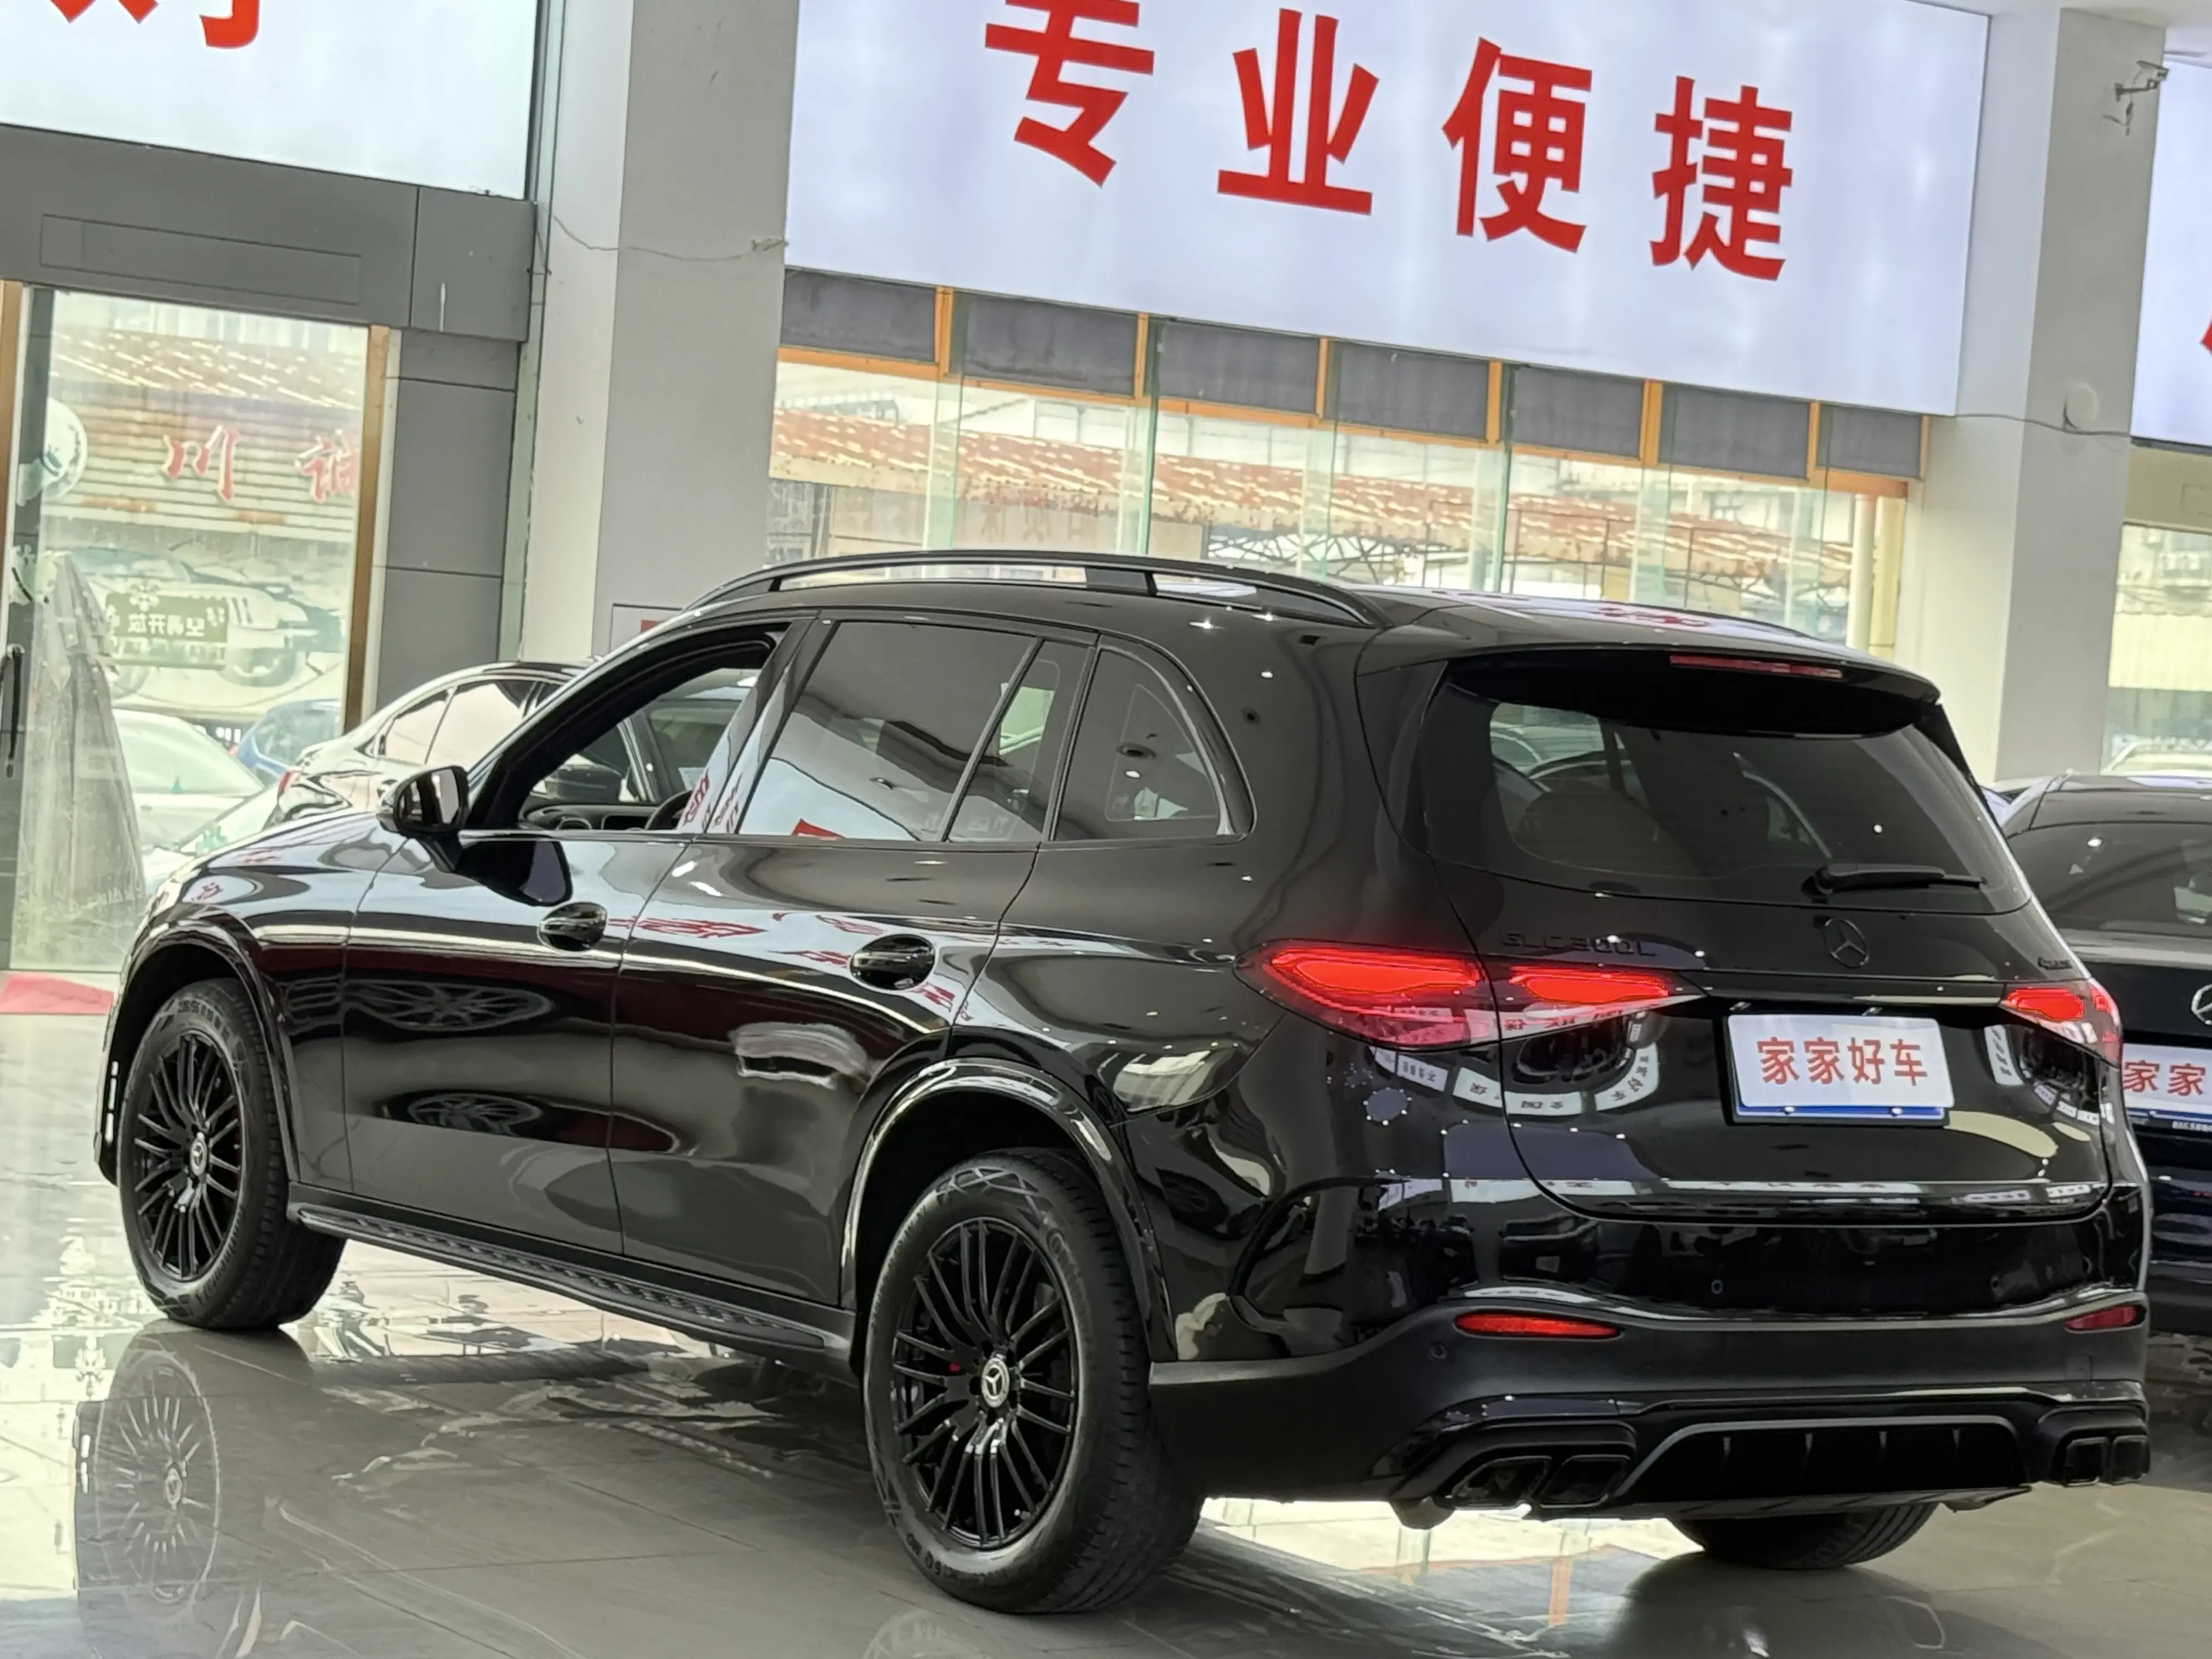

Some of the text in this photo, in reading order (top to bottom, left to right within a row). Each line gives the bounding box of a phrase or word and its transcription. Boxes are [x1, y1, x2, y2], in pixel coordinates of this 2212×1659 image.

[985, 0, 1793, 281] 专业便捷
[1756, 1036, 1928, 1086] 家家好车
[2123, 1060, 2205, 1097] 家家
